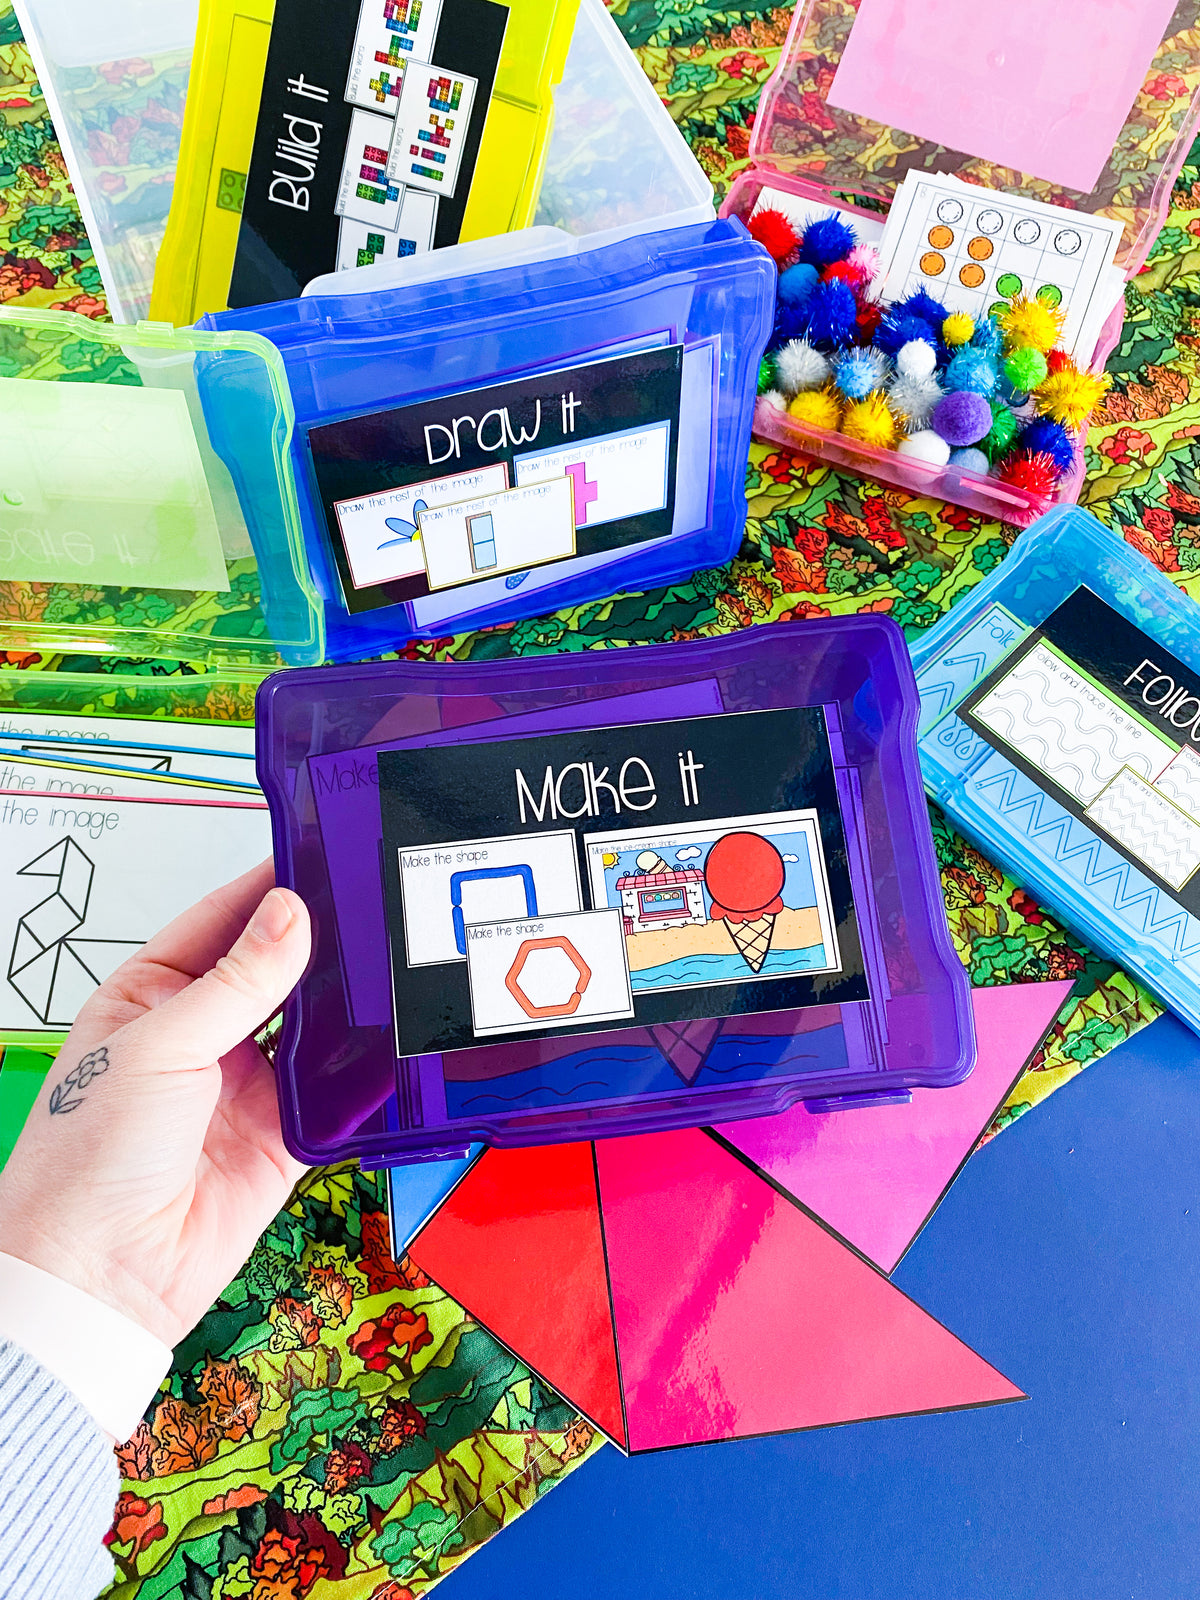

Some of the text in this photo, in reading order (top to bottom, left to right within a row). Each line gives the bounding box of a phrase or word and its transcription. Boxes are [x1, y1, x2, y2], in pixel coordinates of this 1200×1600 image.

[287, 73, 329, 103] it
[410, 76, 463, 181] like
[423, 391, 581, 464] Draw it
[518, 436, 648, 475] Draw the rest of the image
[338, 474, 484, 516] Draw the rest of the image
[420, 485, 552, 523] Draw the rest of the image
[1031, 646, 1142, 739] Follow and trace the line
[45, 727, 110, 741] imae
[0, 765, 36, 791] the
[316, 759, 379, 797] Make
[515, 750, 704, 824] Make it
[1, 799, 121, 840] the image
[402, 849, 489, 869] Make the shape
[467, 922, 545, 941] Make the shape
